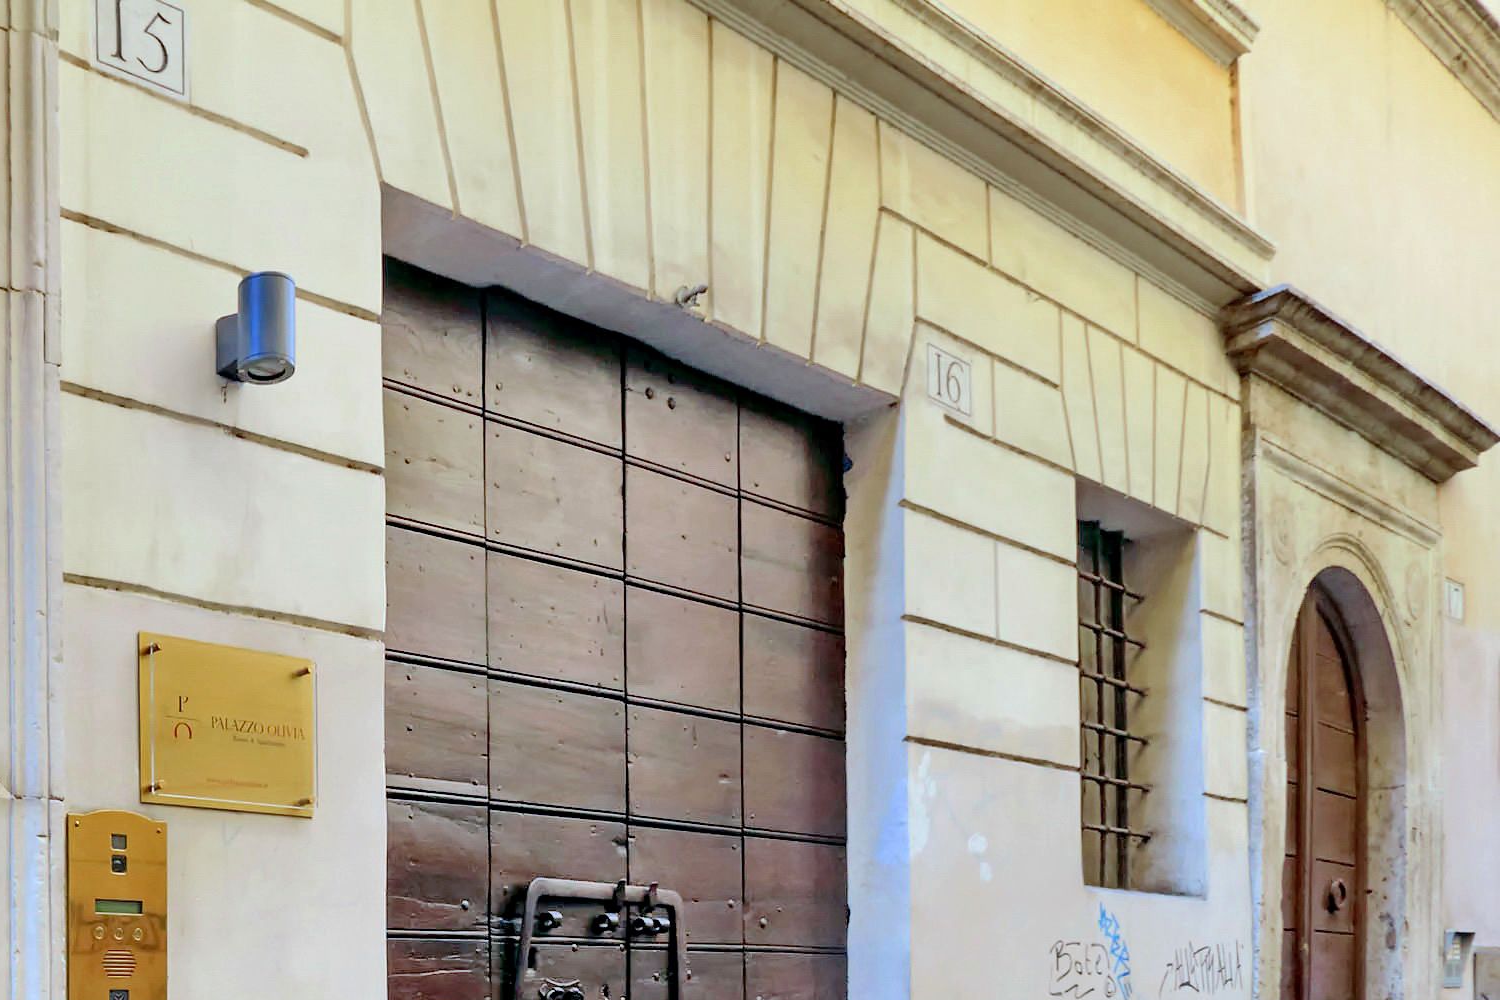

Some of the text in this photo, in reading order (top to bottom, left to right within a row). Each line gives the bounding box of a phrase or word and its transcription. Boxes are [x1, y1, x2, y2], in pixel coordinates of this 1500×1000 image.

[110, 0, 172, 74] 15
[935, 352, 964, 404] 16
[211, 715, 306, 741] PALAZZO OLIVIA
